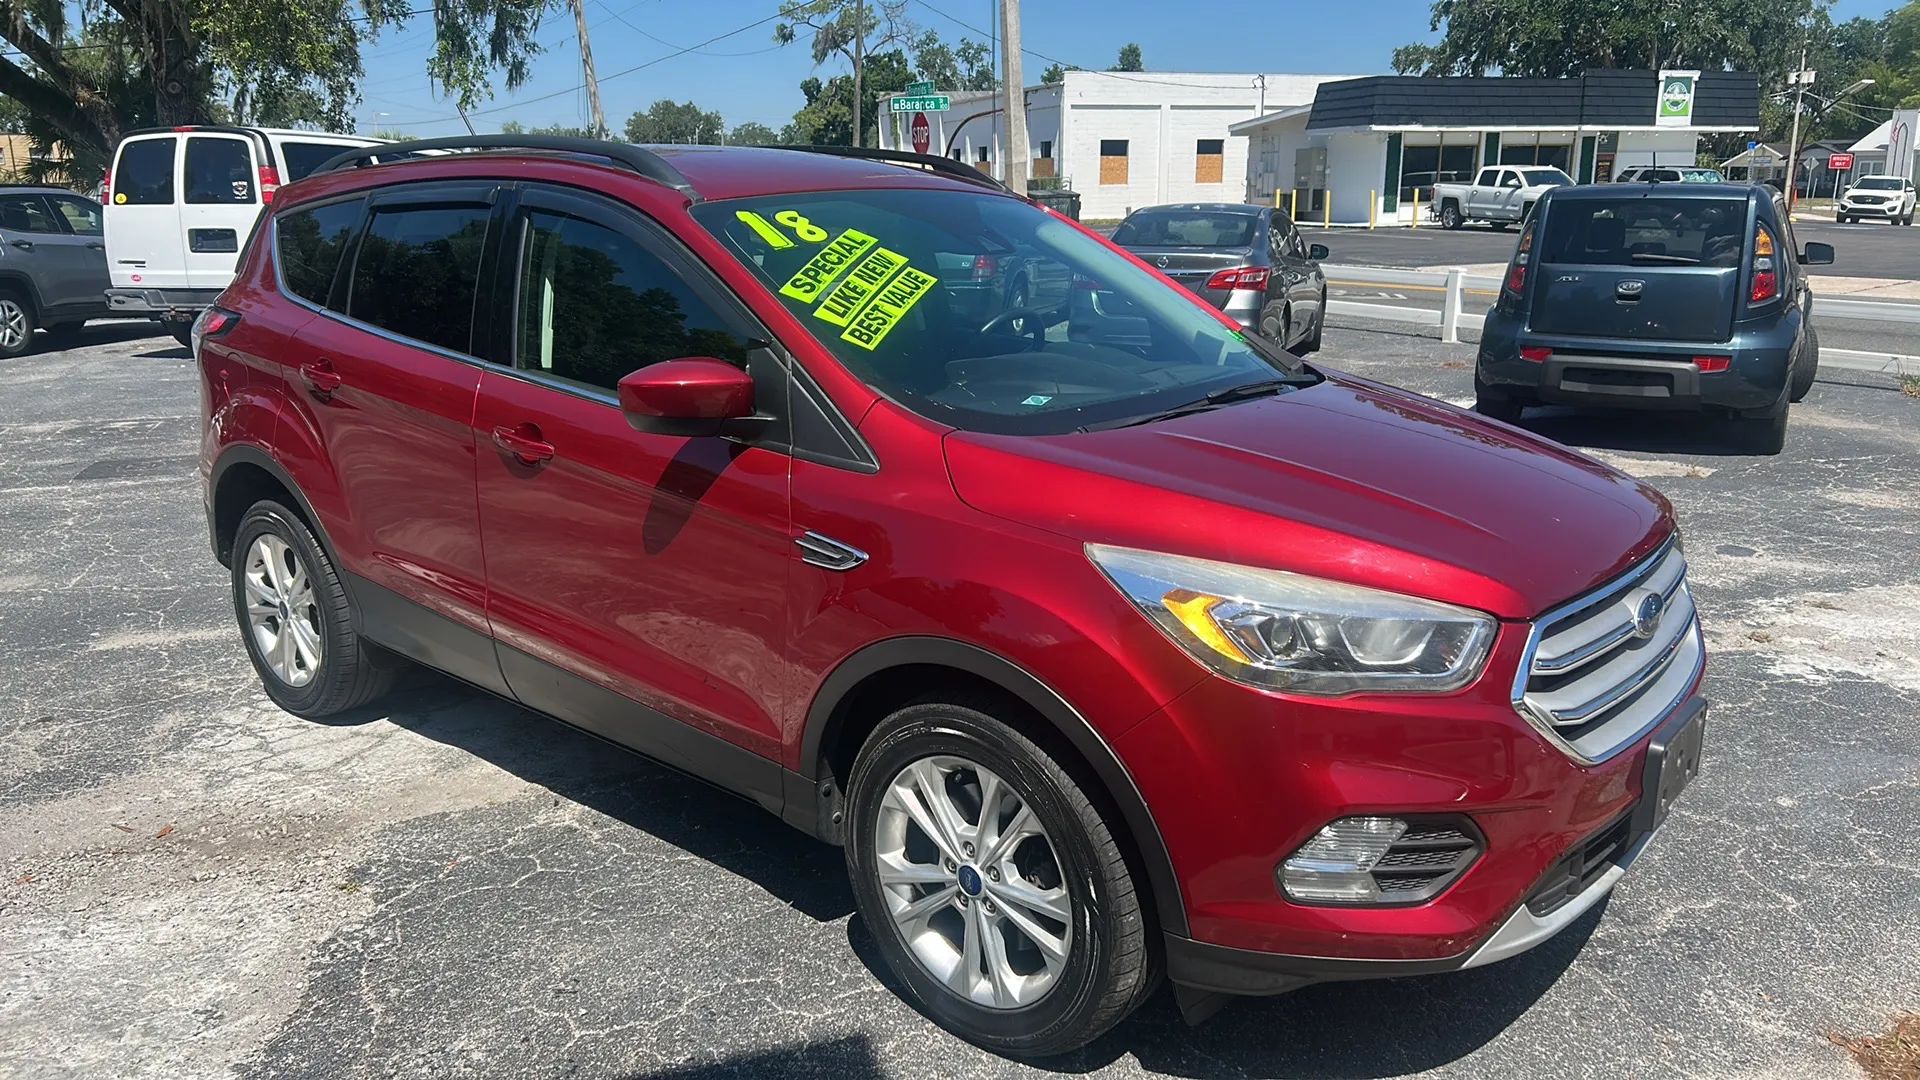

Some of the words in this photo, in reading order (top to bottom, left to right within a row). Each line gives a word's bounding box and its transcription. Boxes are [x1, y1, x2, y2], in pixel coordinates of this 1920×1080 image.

[913, 126, 929, 144] STOP
[735, 210, 829, 250] 18
[790, 233, 866, 294] SPECIAL
[823, 280, 868, 319] LIKE
[852, 251, 895, 286] NEW
[848, 304, 892, 345] BEST
[879, 270, 927, 310] VALUE
